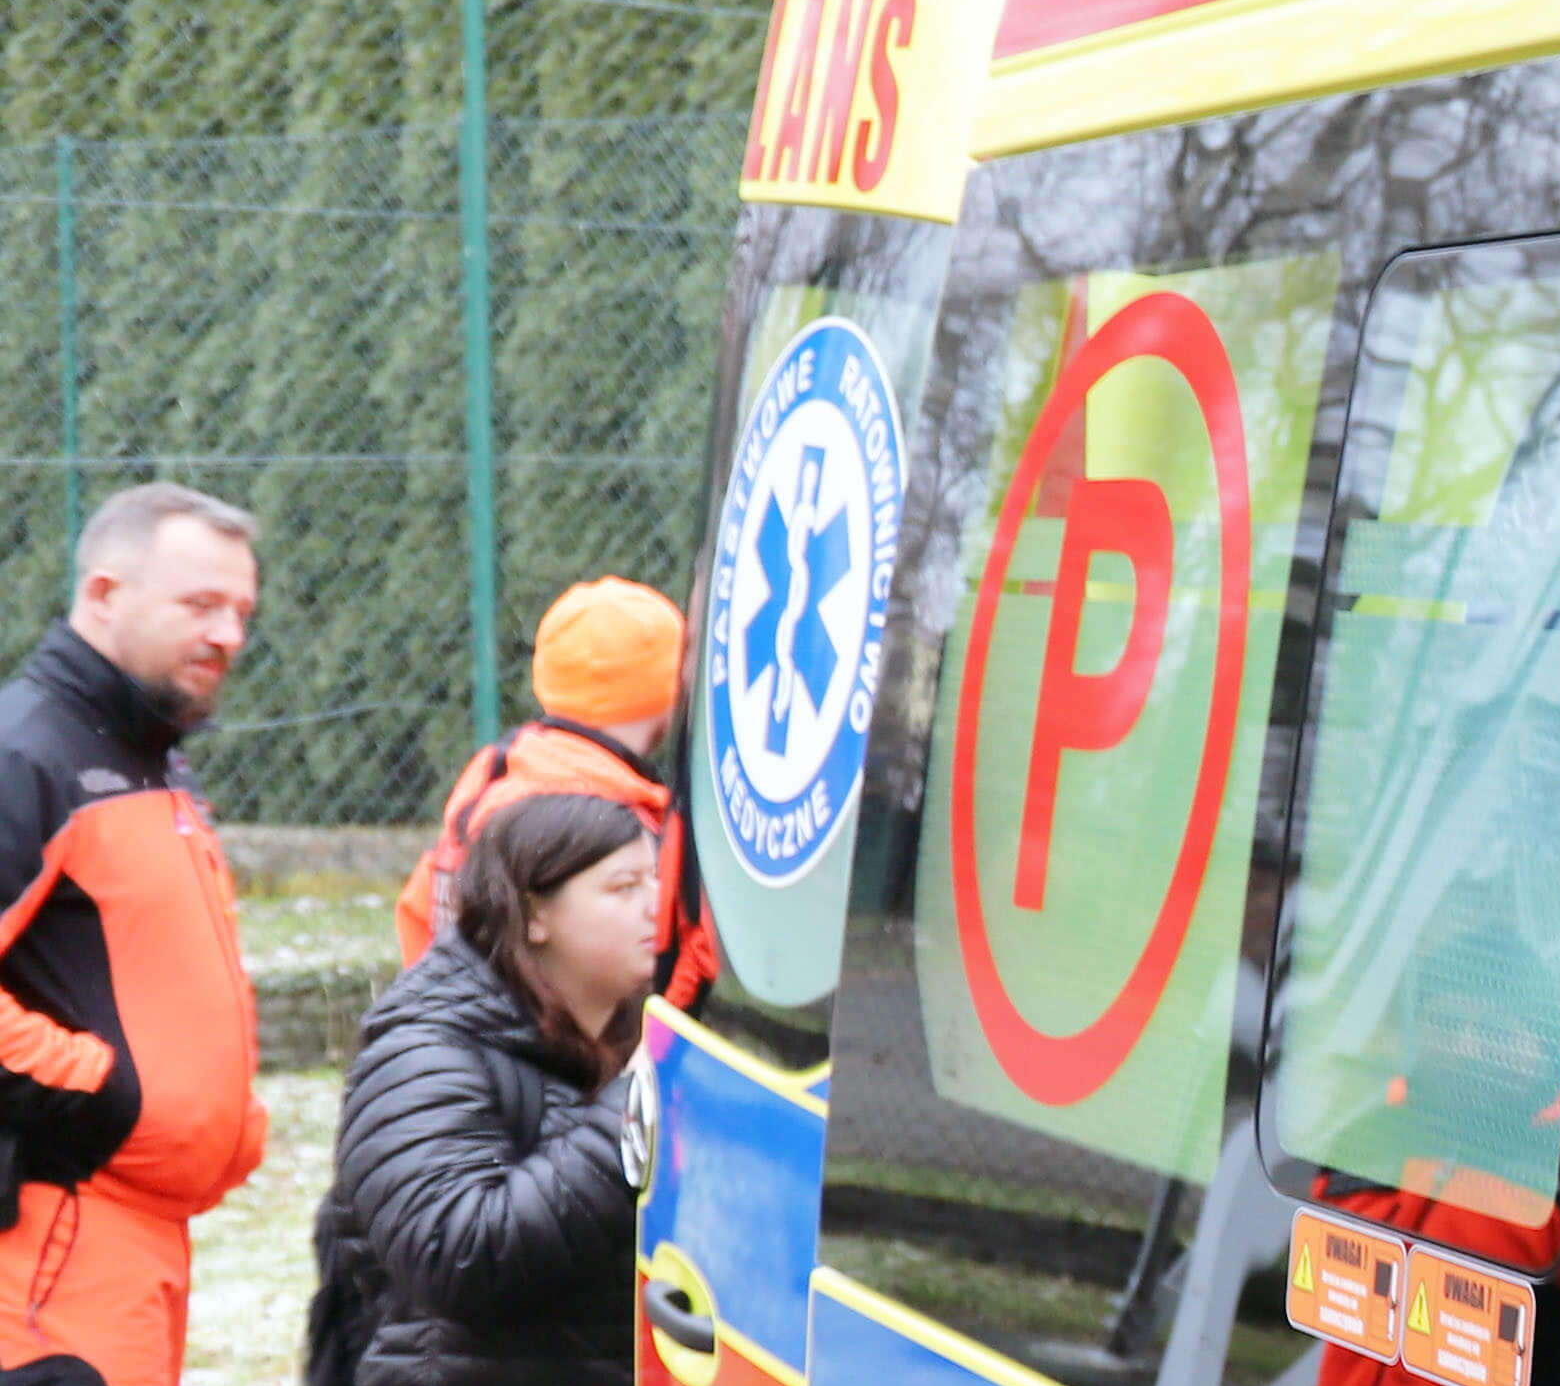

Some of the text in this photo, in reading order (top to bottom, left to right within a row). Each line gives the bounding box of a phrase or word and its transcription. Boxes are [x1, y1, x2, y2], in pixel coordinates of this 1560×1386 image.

[838, 353, 899, 735] RATOWNICTWO
[1013, 478, 1174, 912] P
[719, 744, 833, 861] MEDYCZNE
